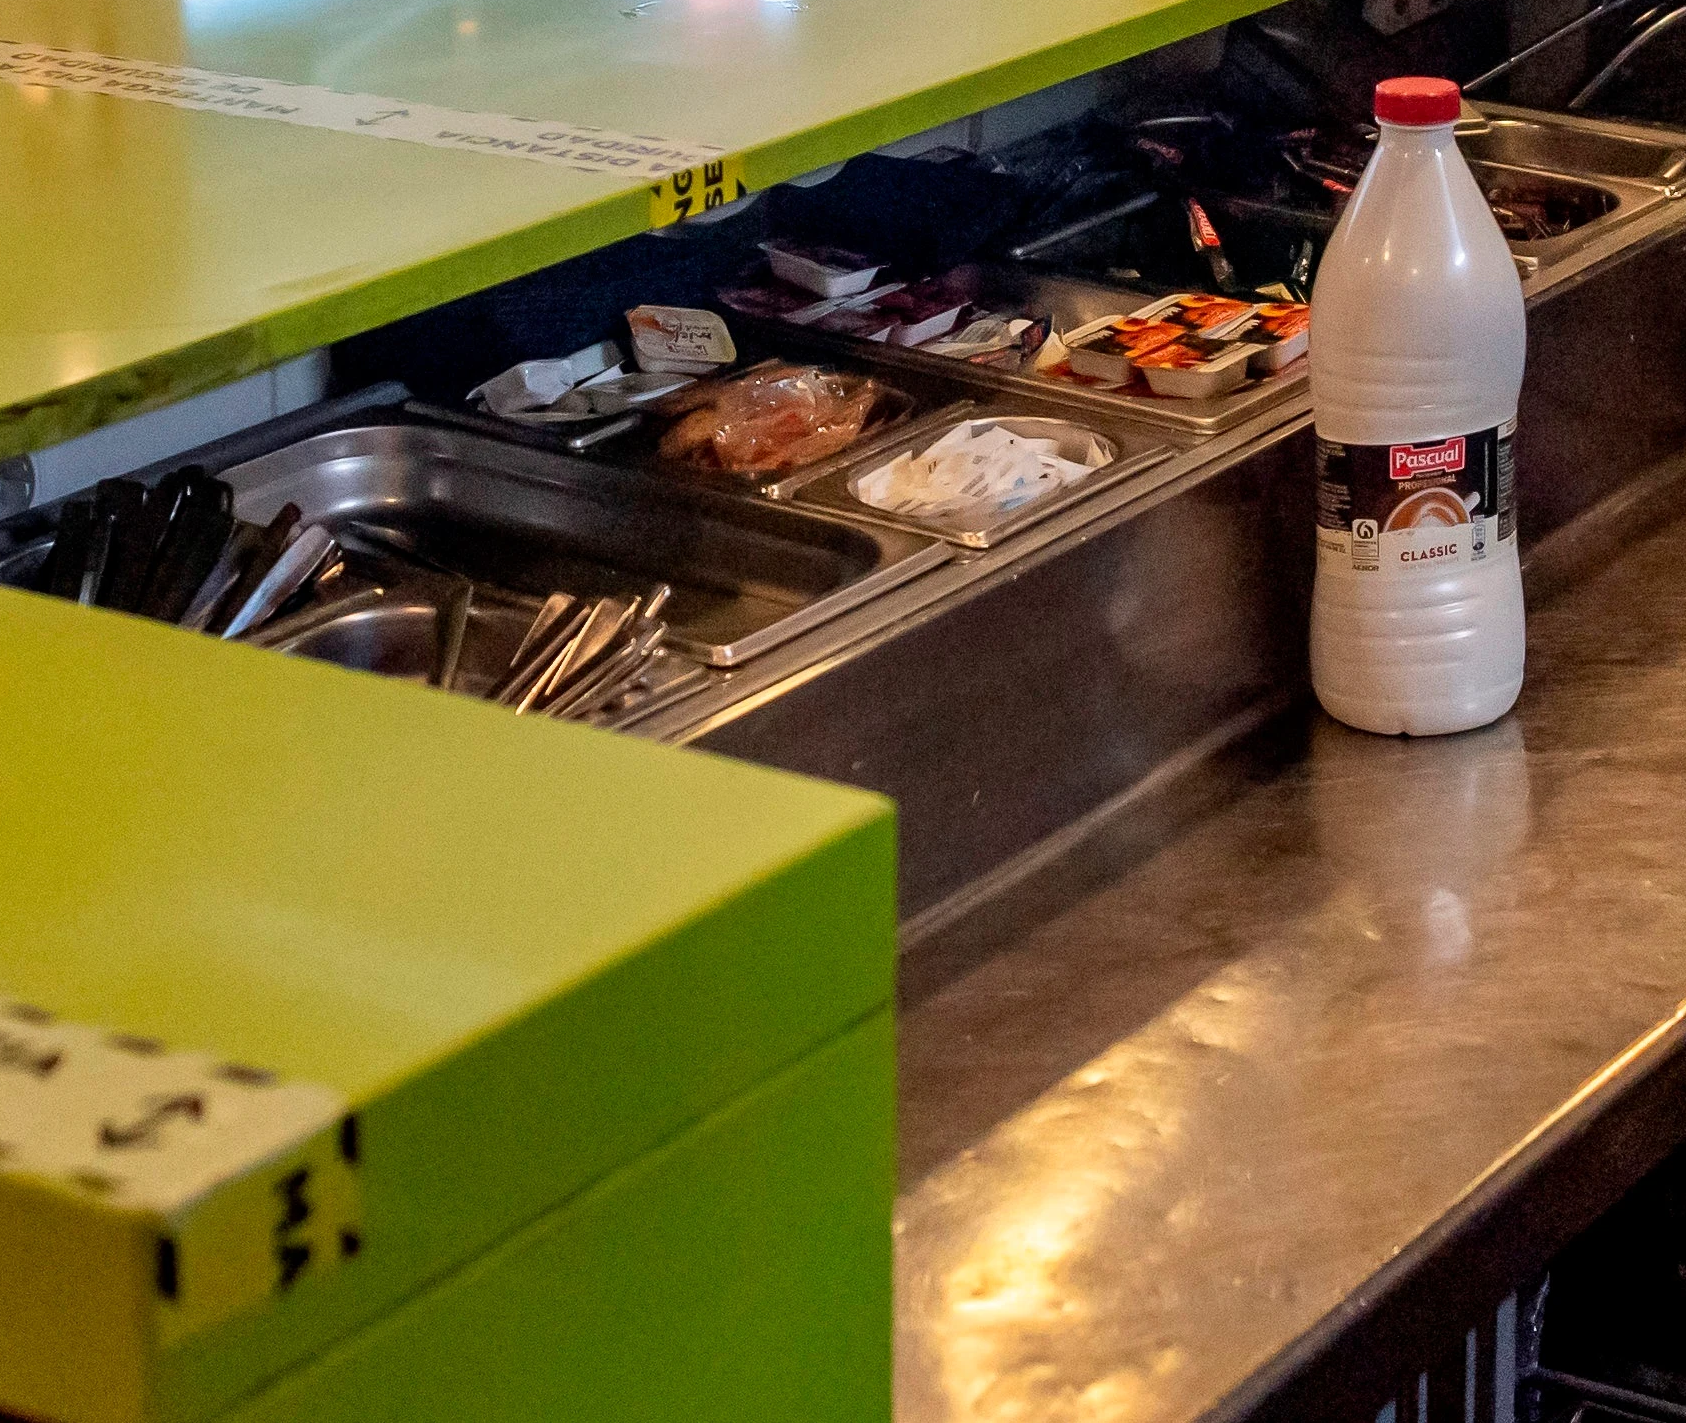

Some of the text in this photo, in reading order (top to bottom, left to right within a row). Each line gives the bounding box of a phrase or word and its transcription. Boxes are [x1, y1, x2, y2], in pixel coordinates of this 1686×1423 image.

[103, 78, 301, 116] MANTENGA
[436, 130, 640, 167] DISTANCIA
[1395, 444, 1460, 470] Pascual
[1400, 543, 1458, 562] CLASSIC
